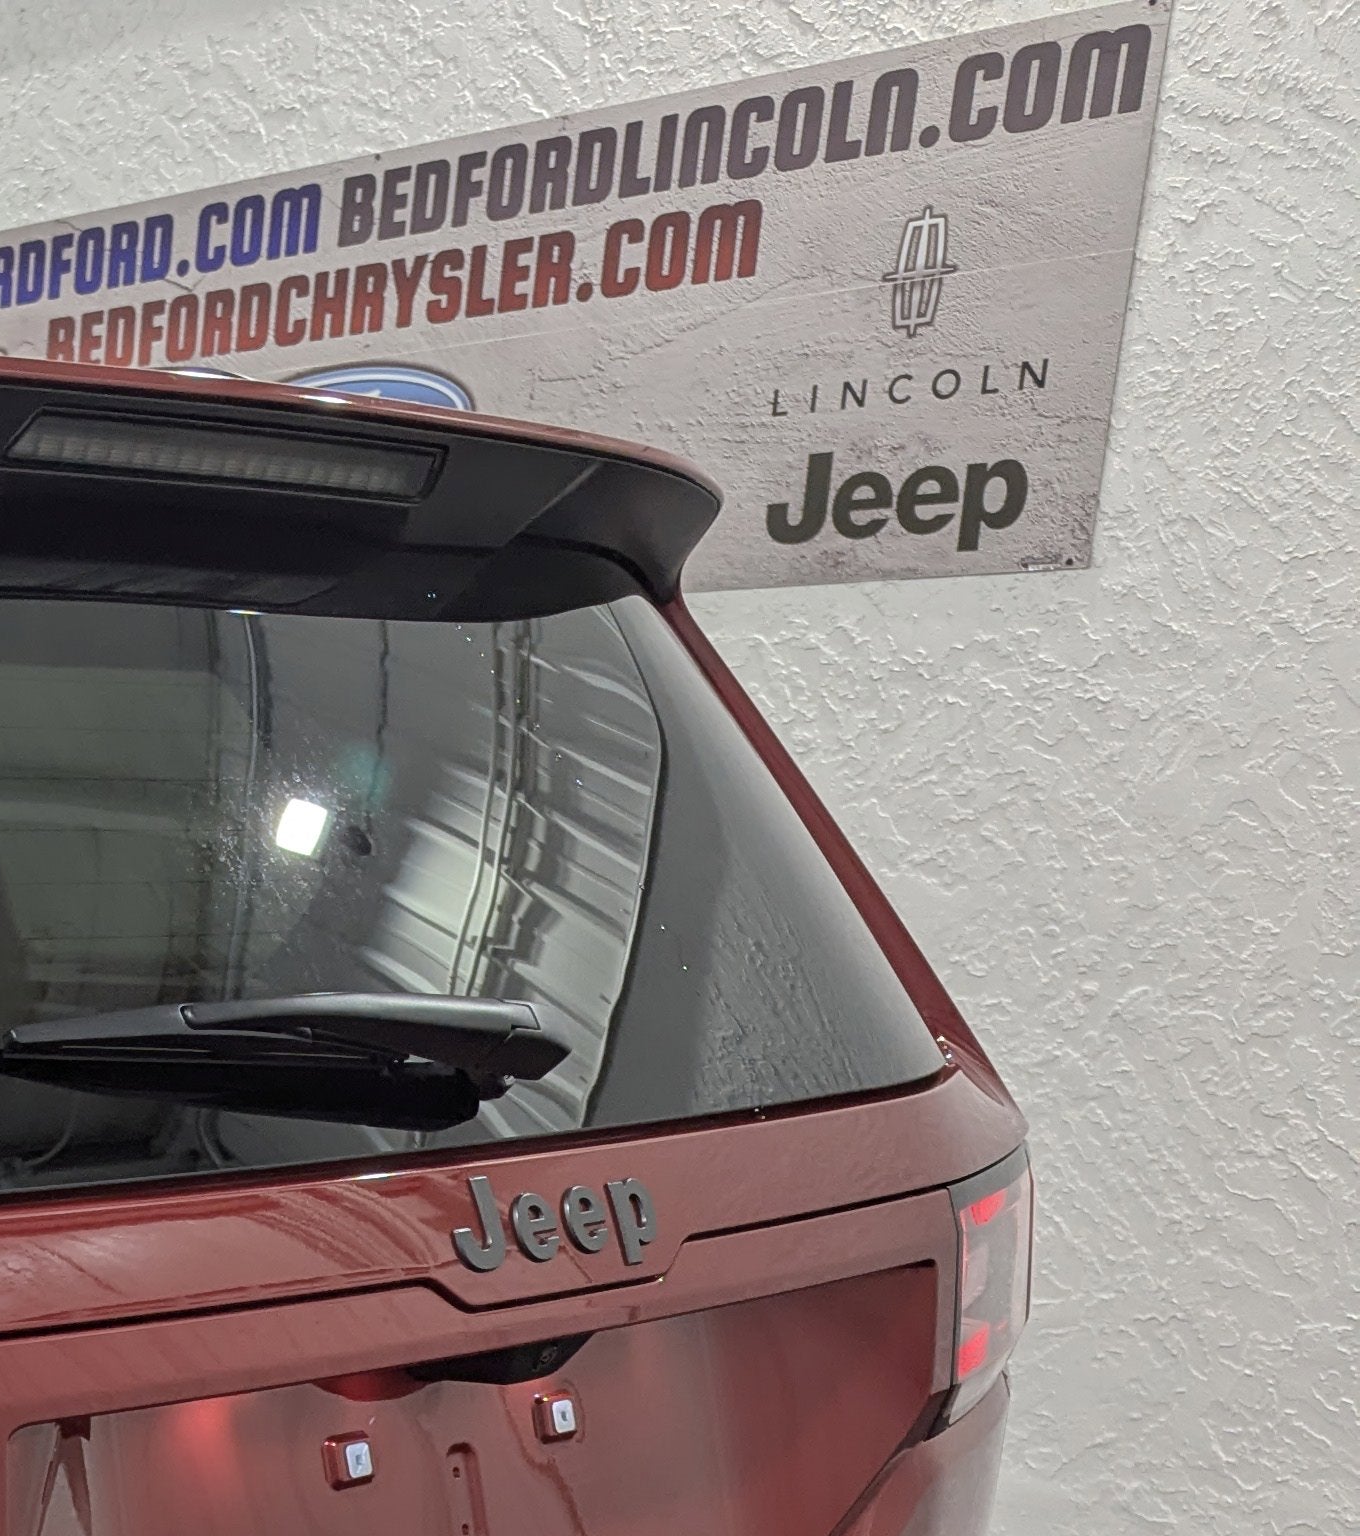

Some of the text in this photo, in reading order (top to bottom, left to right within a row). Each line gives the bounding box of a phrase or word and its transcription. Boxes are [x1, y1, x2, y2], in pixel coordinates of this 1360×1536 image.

[337, 23, 1152, 248] BEDFORDLINCOLN.COM
[47, 199, 763, 367] BEDFORDCHRYSLER.COM
[770, 358, 1050, 418] LINCOLN
[765, 451, 1029, 552] Jeep
[452, 1175, 659, 1272] Jeep
